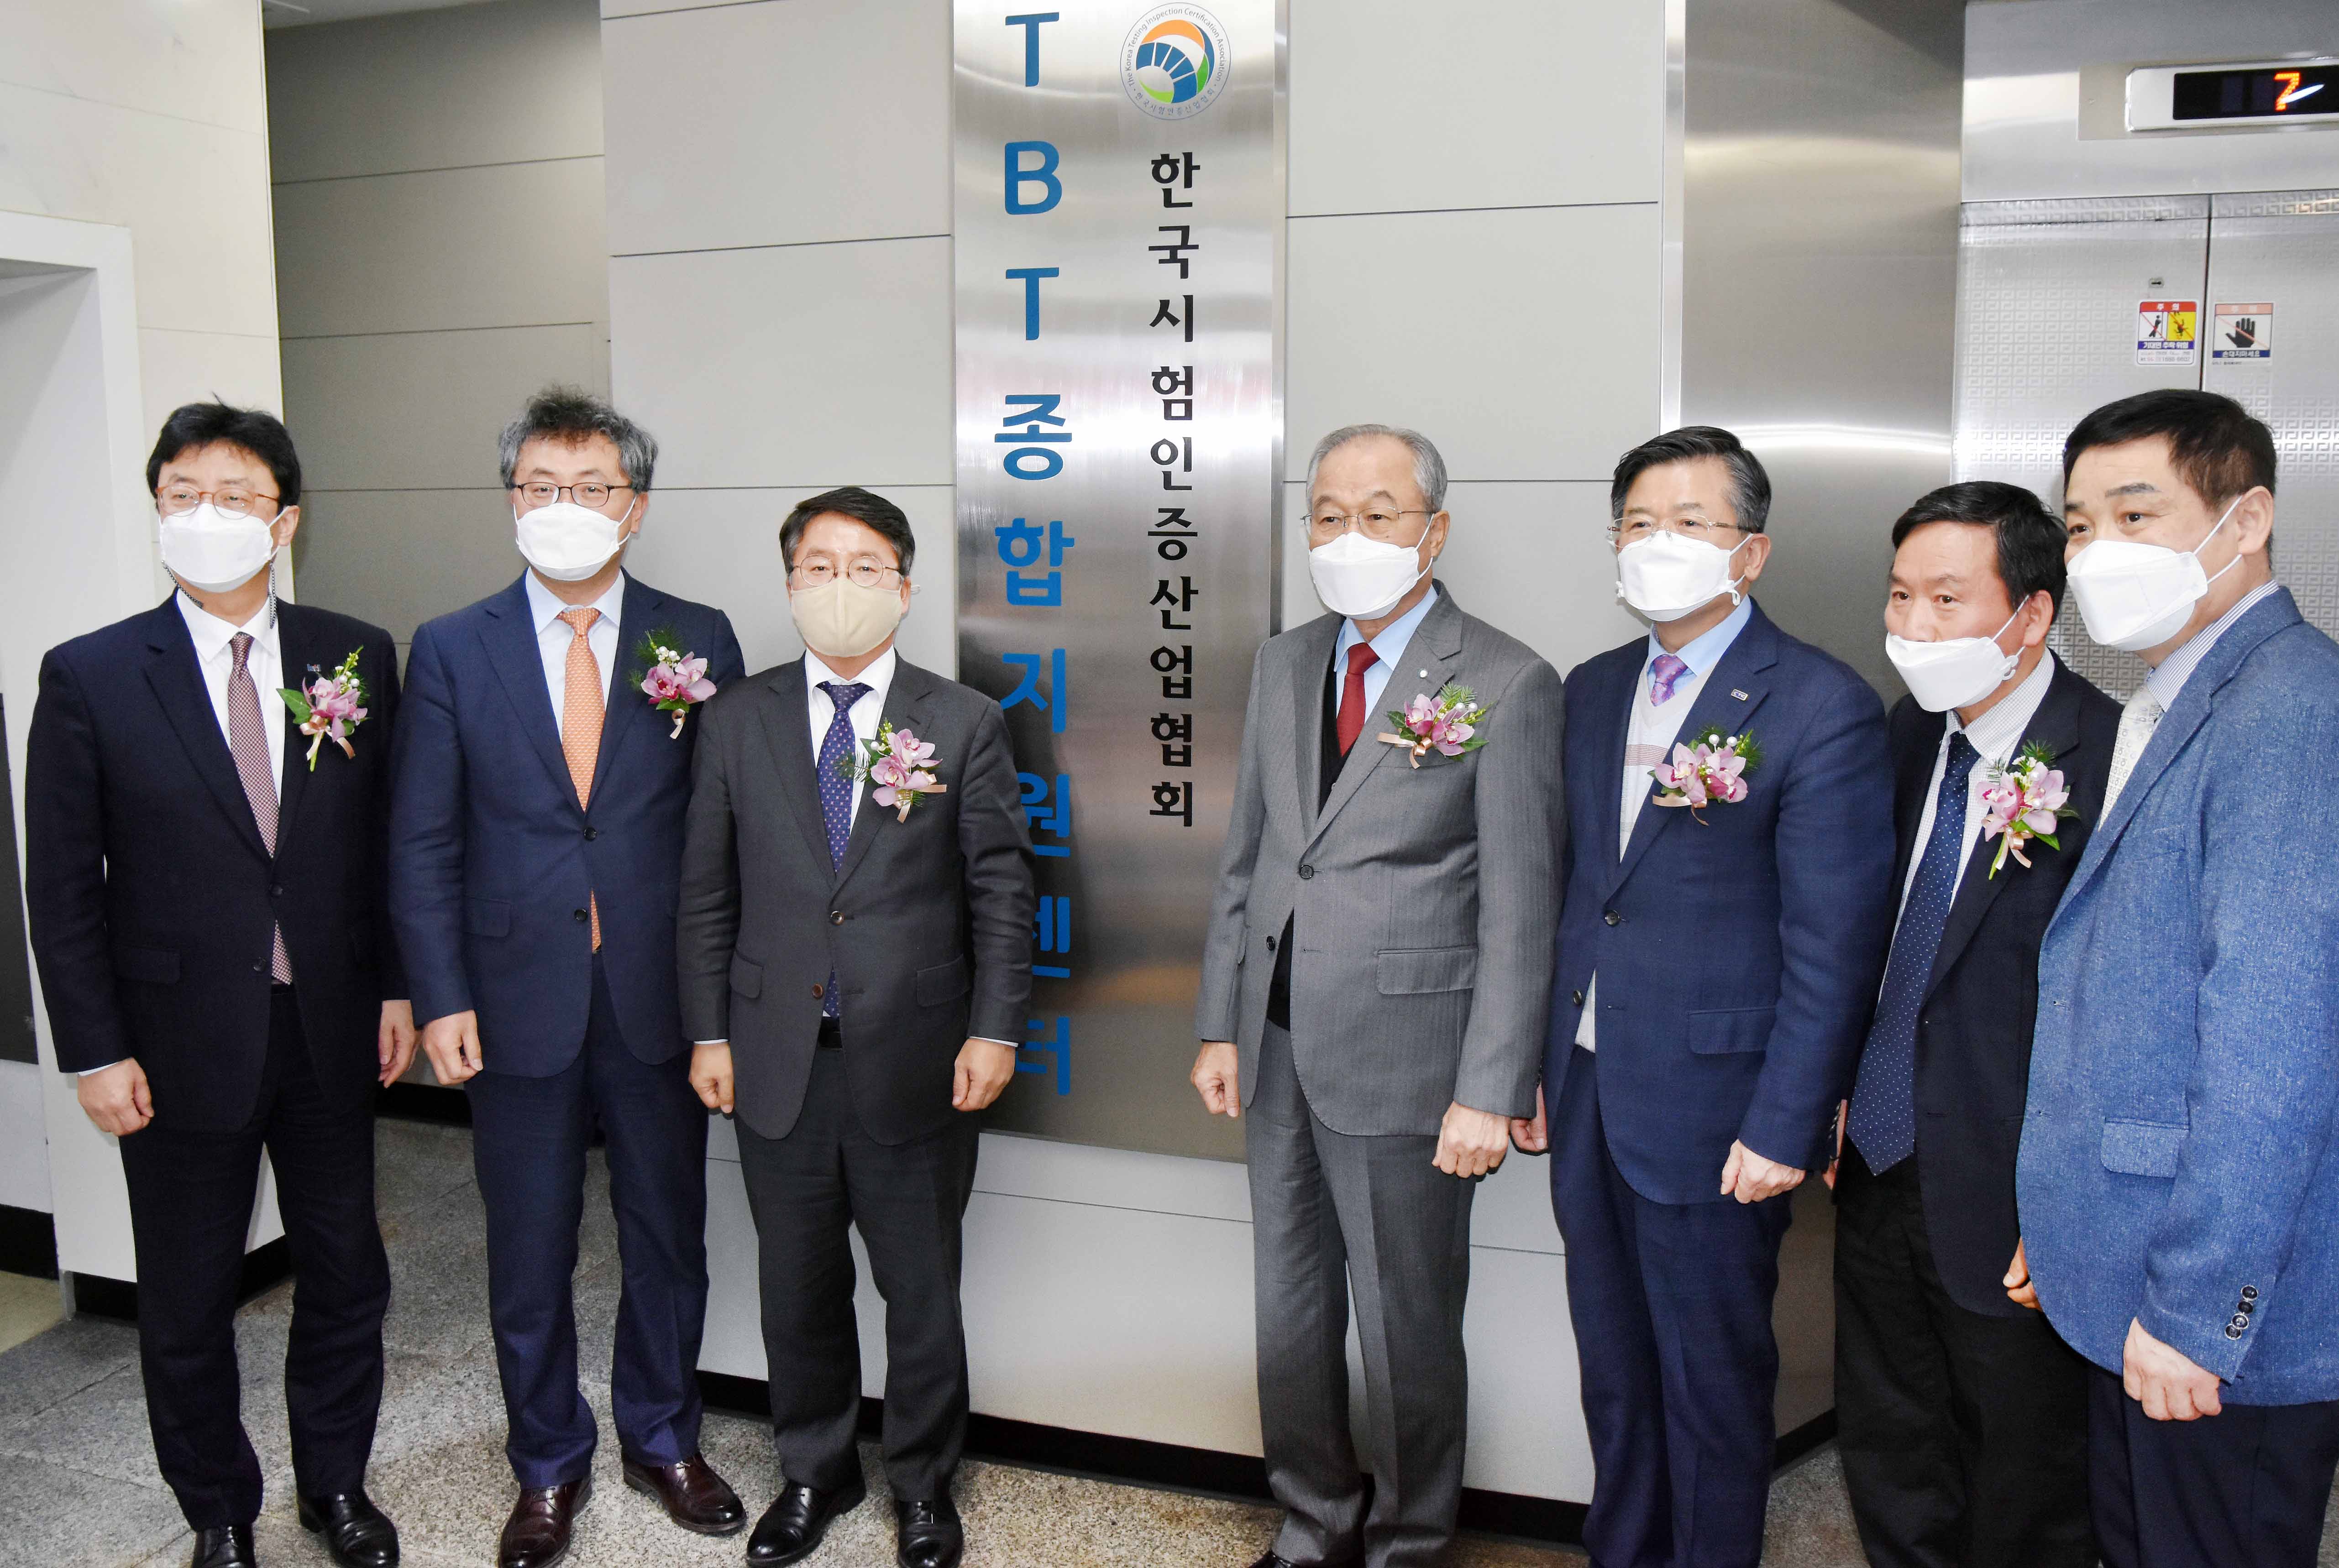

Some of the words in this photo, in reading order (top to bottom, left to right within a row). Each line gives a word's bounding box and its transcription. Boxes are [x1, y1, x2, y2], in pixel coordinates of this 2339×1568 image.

[1128, 24, 1148, 47] Testing
[1146, 8, 1182, 25] Inspection
[1185, 8, 1219, 38] Certification
[1216, 38, 1225, 82] Association
[1148, 152, 1201, 827] 한국시험인증산업협회
